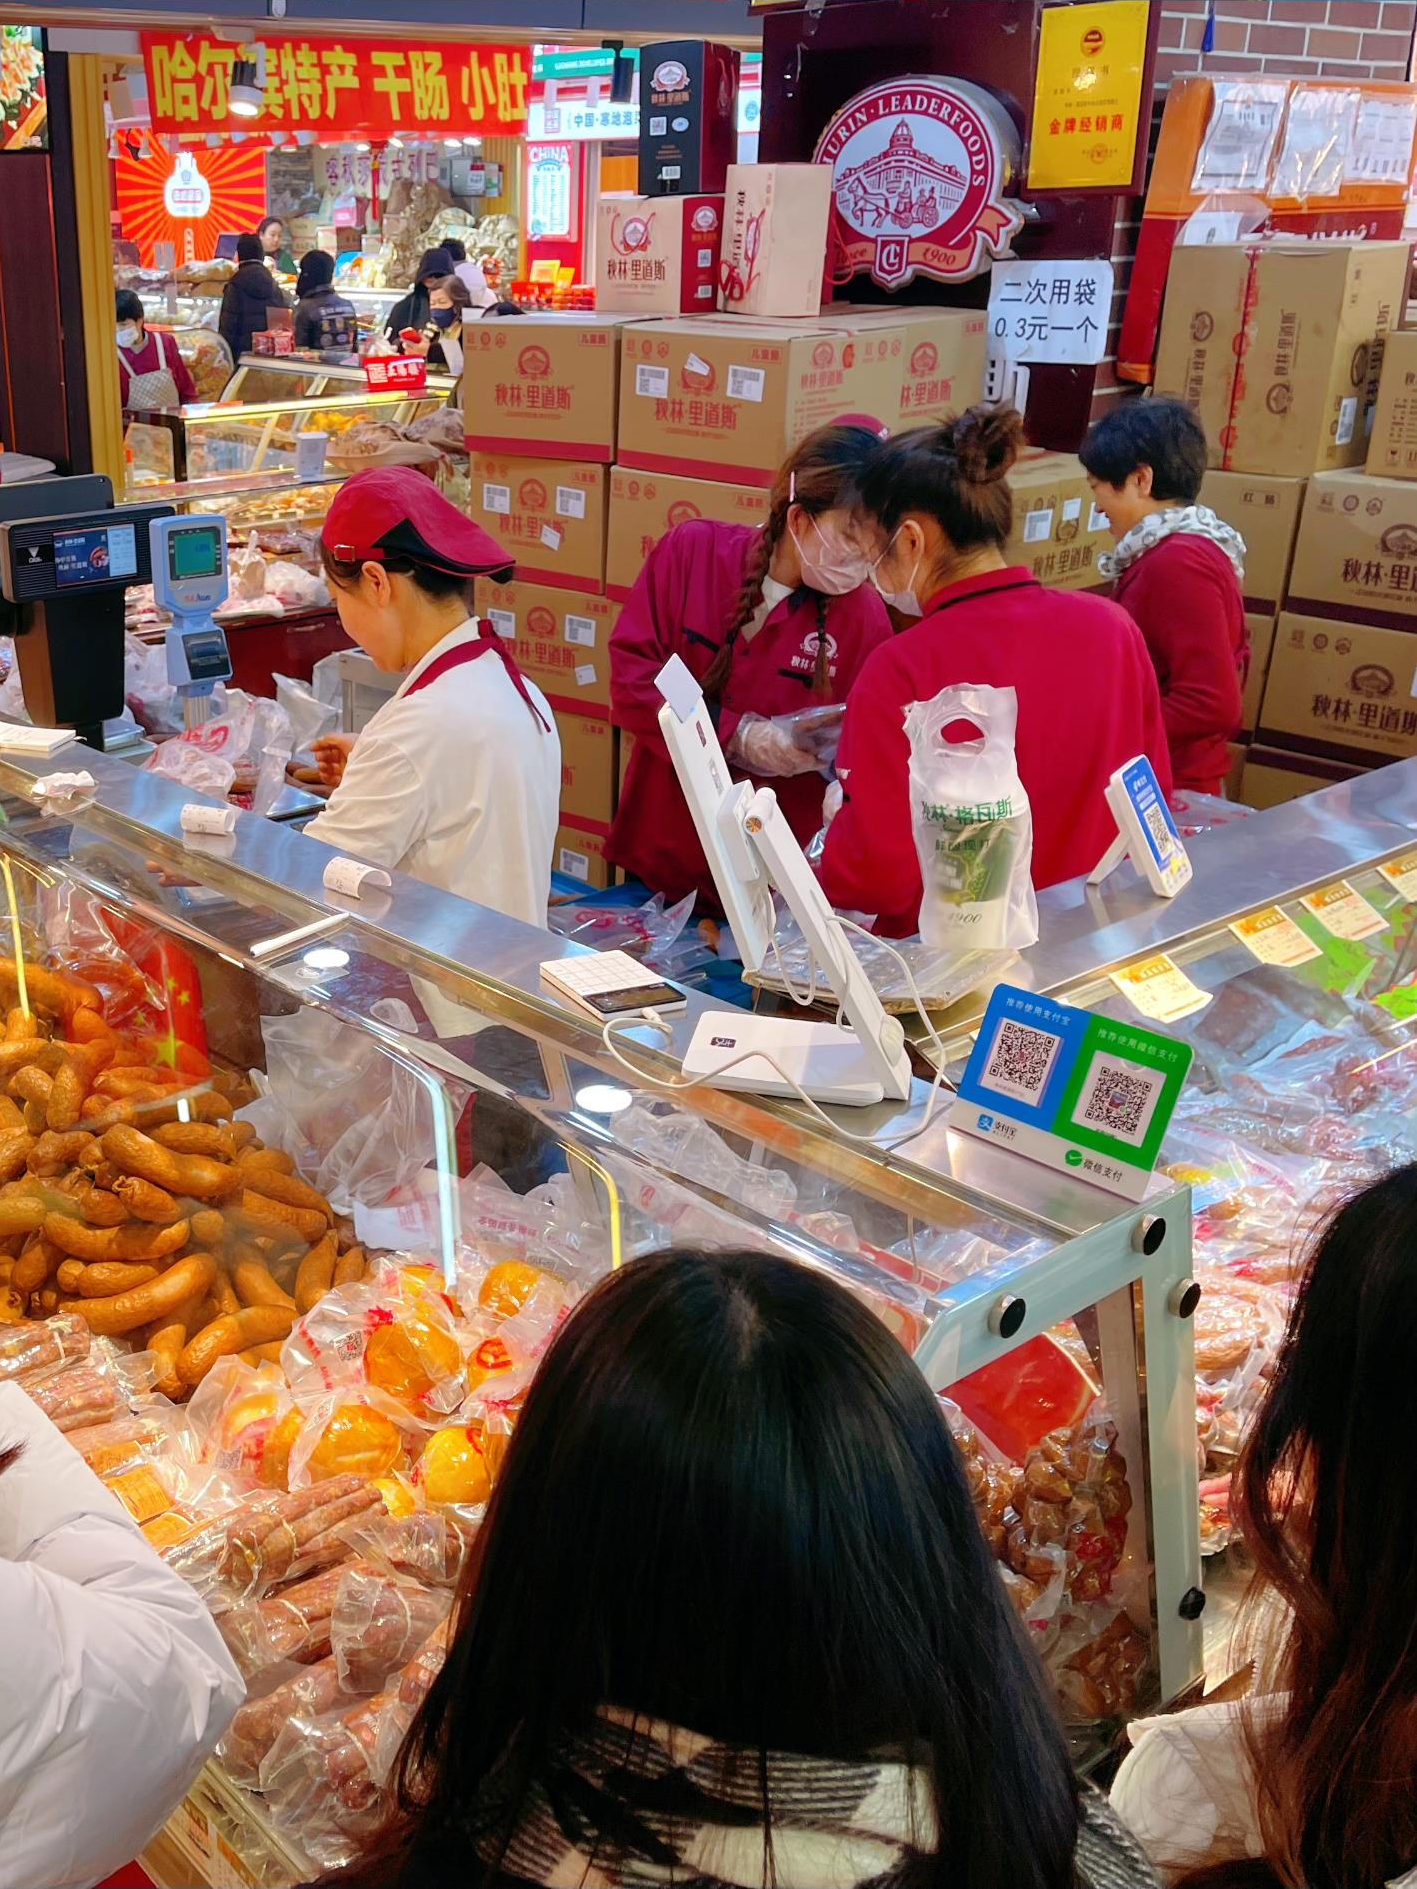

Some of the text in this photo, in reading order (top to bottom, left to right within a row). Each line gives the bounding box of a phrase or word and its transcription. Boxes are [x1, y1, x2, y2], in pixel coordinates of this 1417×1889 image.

[370, 50, 448, 123] 干肠
[460, 47, 529, 124] 小肚
[874, 90, 987, 189] LEADERFOODS
[1048, 113, 1124, 136] 金牌经销商
[607, 258, 668, 282] 秋林·里道斯
[999, 276, 1098, 309] 二次用袋
[993, 316, 1099, 343] 0.3元一个
[494, 382, 572, 412] 秋林·里道斯
[654, 399, 738, 431] 秋林·里道斯
[1005, 996, 1179, 1065] 推荐使用支付宝 推荐使用微信支付
[993, 1118, 1018, 1140] 支付宝
[1083, 1157, 1125, 1184] 微信支付
